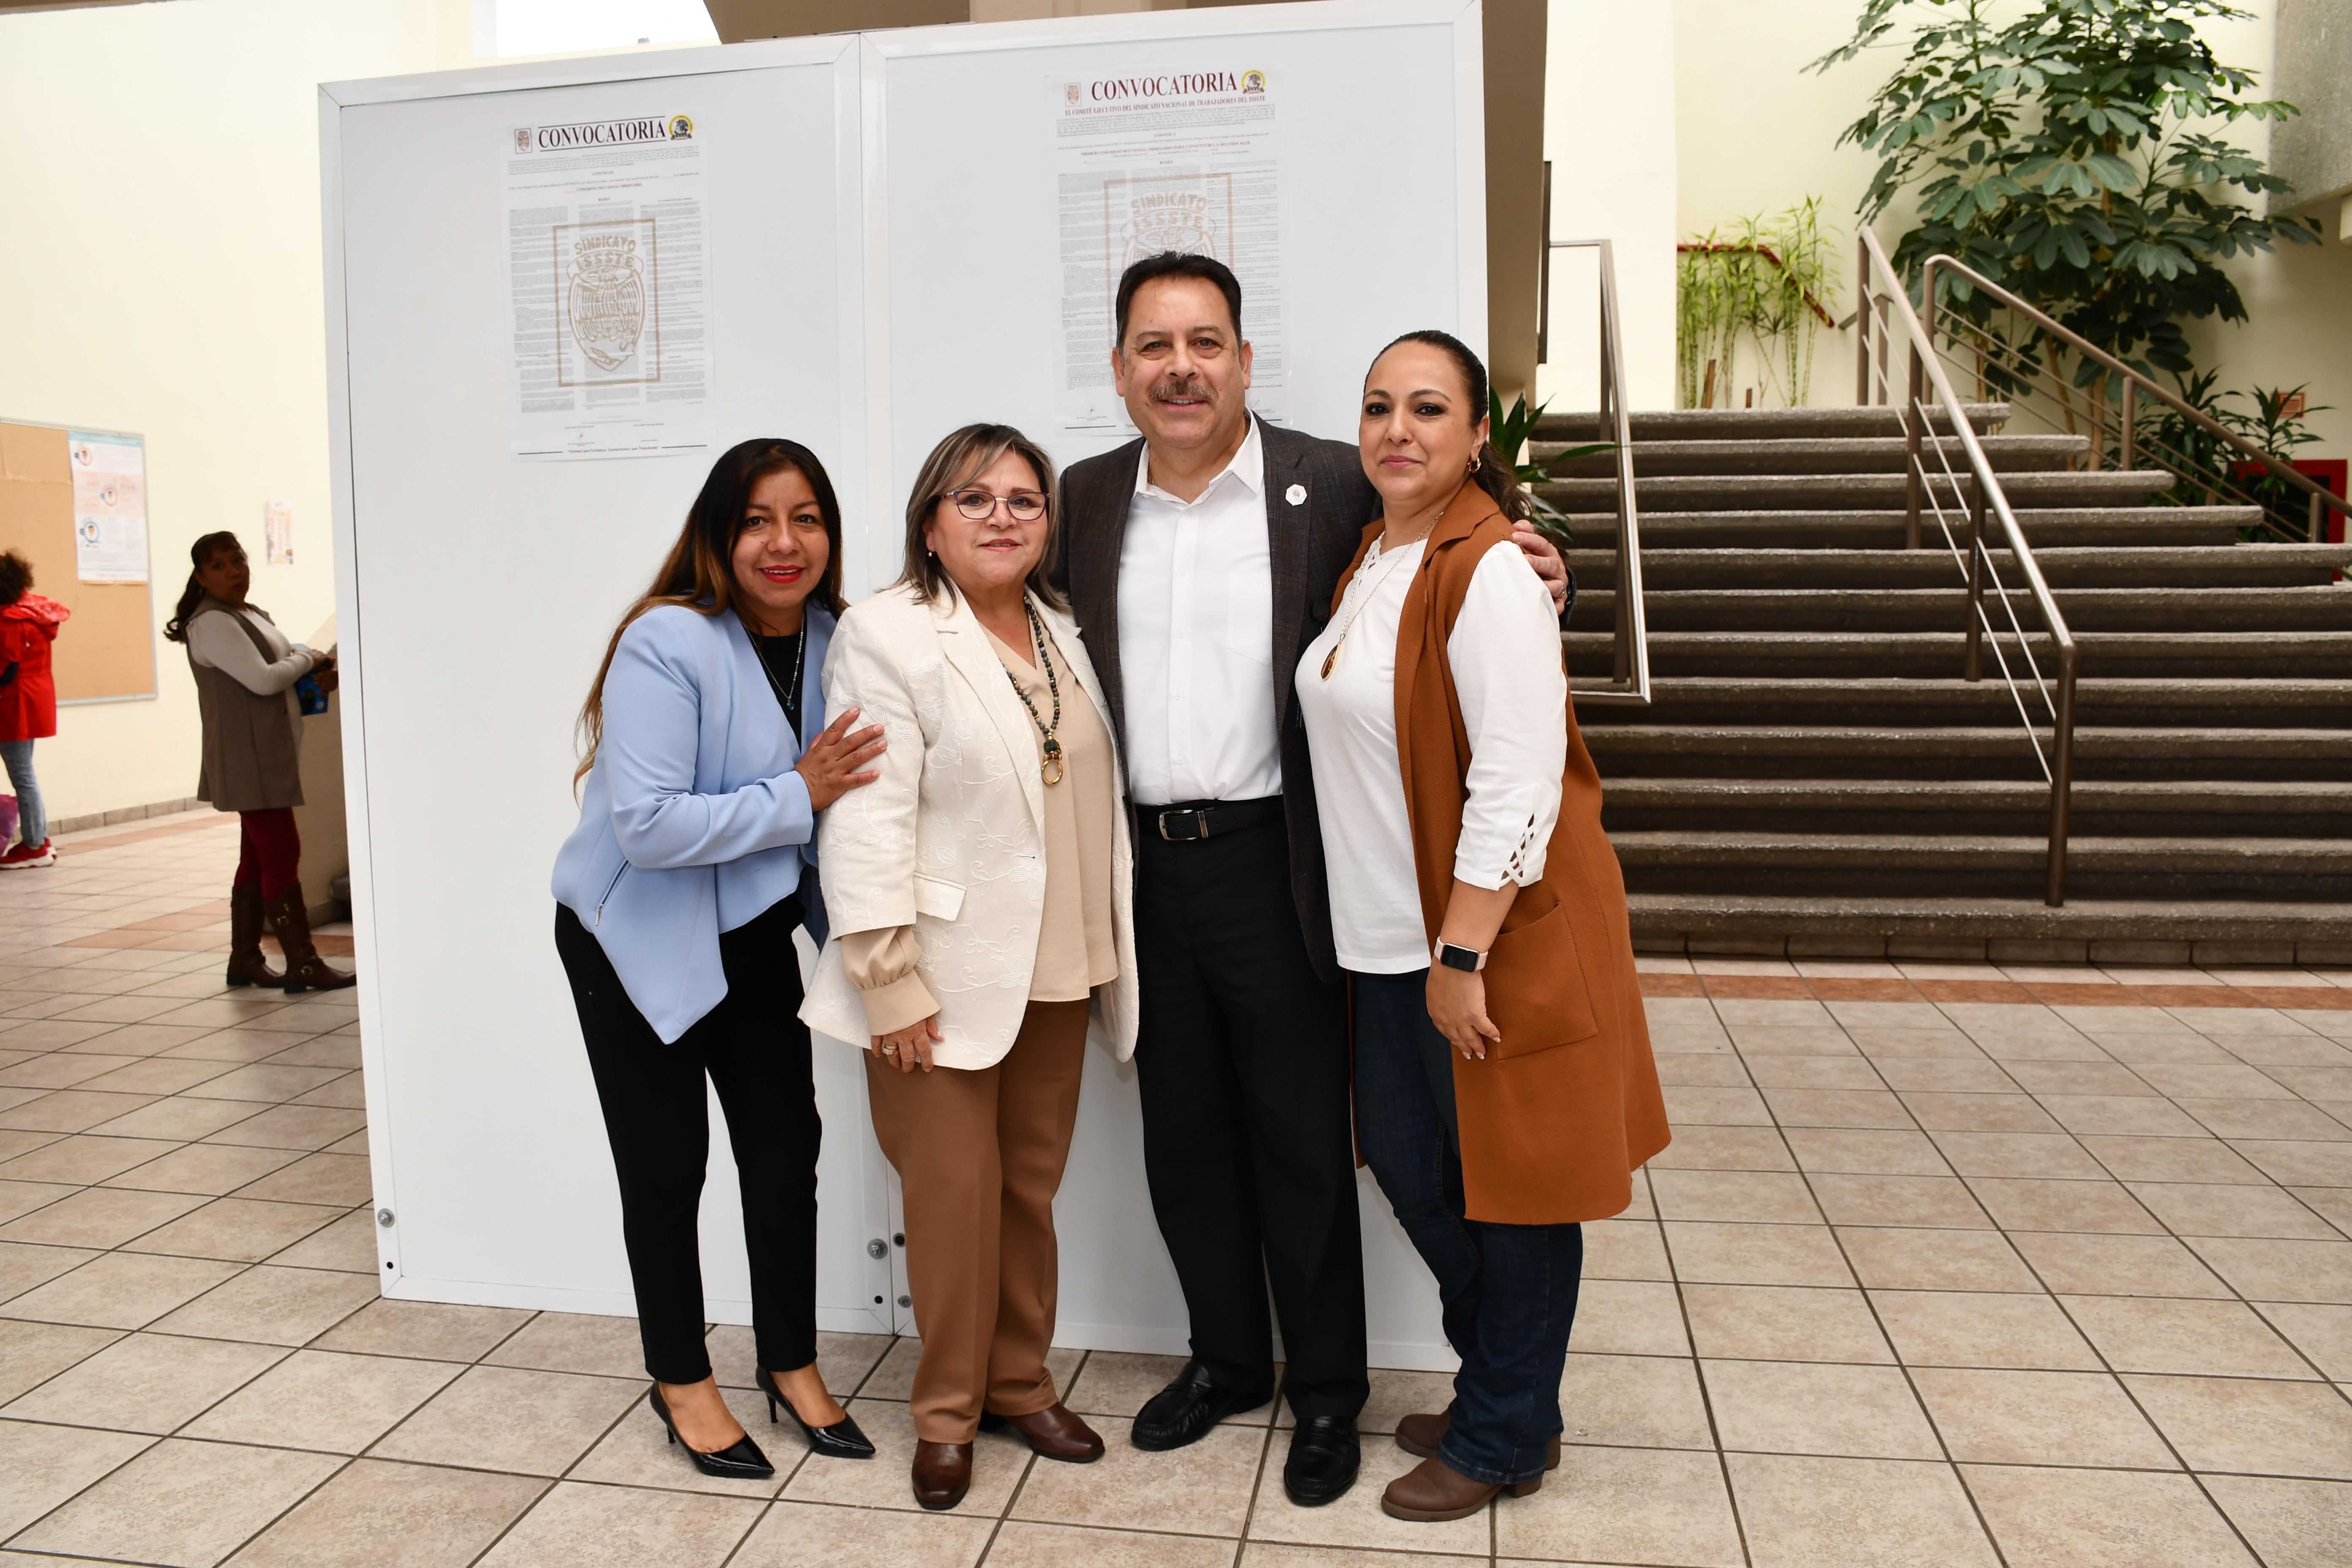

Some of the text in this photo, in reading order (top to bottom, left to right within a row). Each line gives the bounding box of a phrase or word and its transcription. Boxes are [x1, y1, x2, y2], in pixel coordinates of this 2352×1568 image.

[1091, 71, 1238, 101] CONVOCATORIA
[1073, 107, 1092, 115] COMITÉ
[1093, 106, 1122, 114] EJECUTIVO
[1133, 103, 1160, 111] SINDICATO
[1197, 98, 1237, 106] TRABAJADORES
[539, 120, 666, 148] CONVOCATORIA
[1130, 191, 1207, 215] SINDICATO
[1132, 210, 1204, 234] ISSSTE
[574, 235, 636, 255] SINDICATO
[576, 251, 634, 271] ISSSTE
